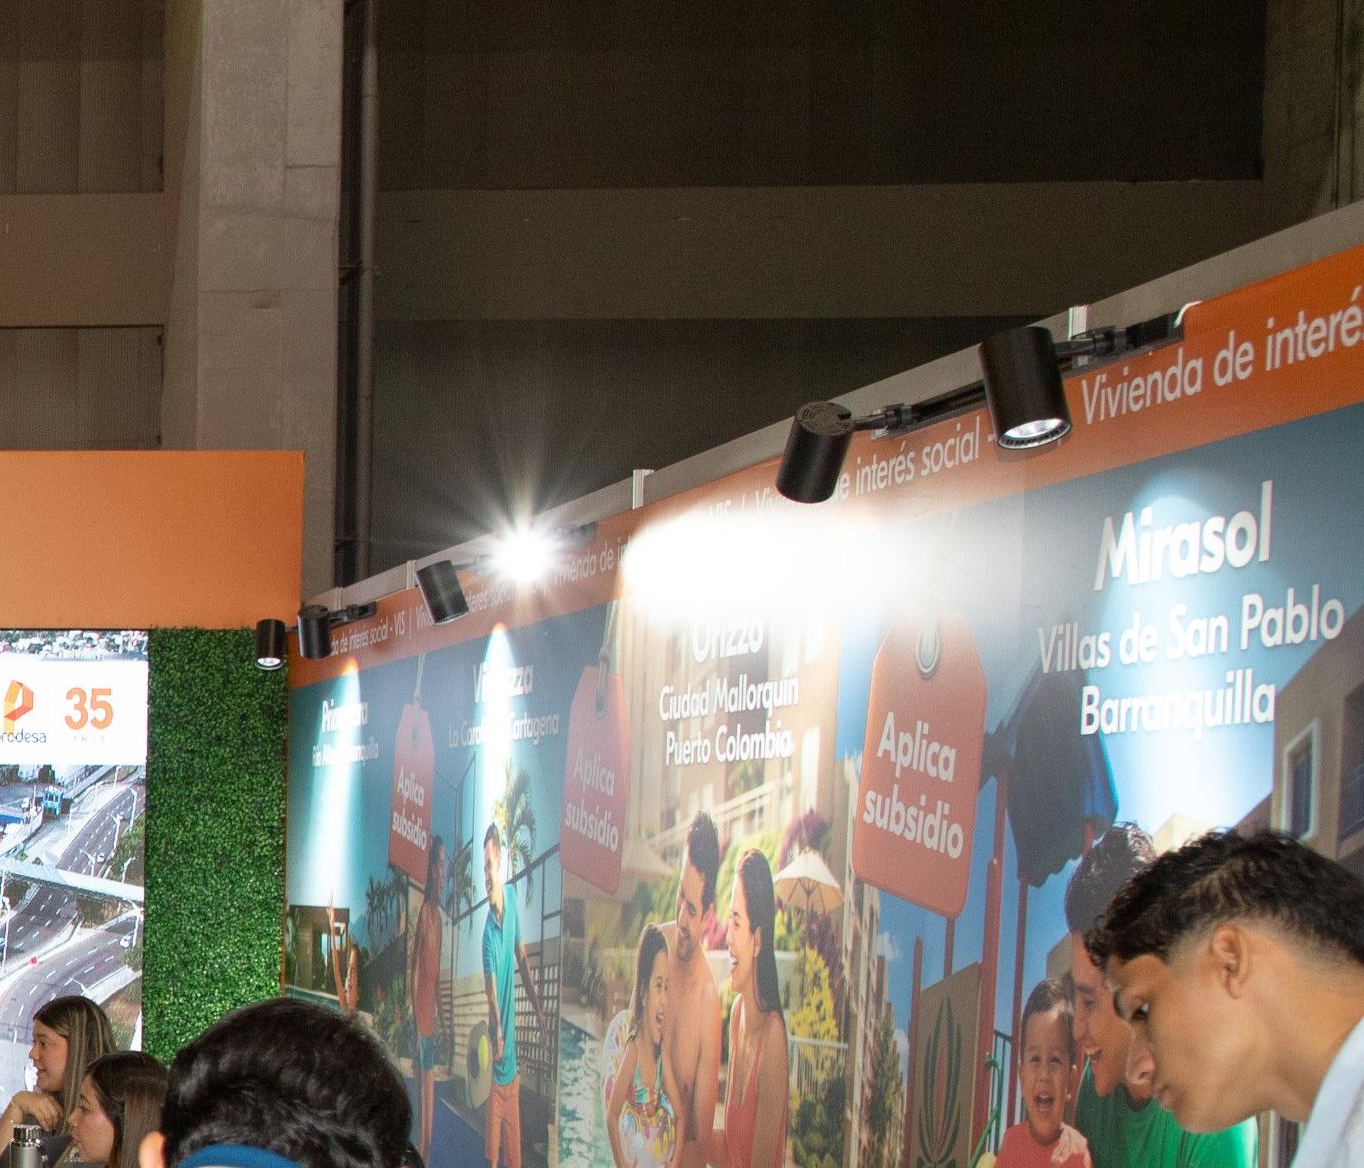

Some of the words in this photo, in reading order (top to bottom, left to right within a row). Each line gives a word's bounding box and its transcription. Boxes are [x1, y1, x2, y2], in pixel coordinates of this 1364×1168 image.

[1080, 344, 1203, 426] Vivienda
[1212, 329, 1255, 387] de
[1265, 285, 1364, 372] interé
[855, 439, 915, 493] interés
[920, 413, 982, 476] social
[1093, 480, 1272, 591] Mirasol
[1037, 621, 1111, 675] Villas
[1118, 609, 1161, 661] de
[1168, 604, 1231, 655] San
[1239, 583, 1345, 651] Pablo
[64, 686, 114, 731] 35
[659, 676, 710, 721] Ciudad
[1080, 667, 1276, 741] Barranquilla
[572, 748, 615, 798] Aplica
[665, 728, 712, 766] Puerto
[714, 719, 794, 763] Colombia
[876, 711, 957, 783] Aplica
[396, 766, 426, 806] Aplica
[391, 811, 428, 851] subsidio
[564, 801, 619, 853] subsidio
[863, 785, 964, 860] subsidio
